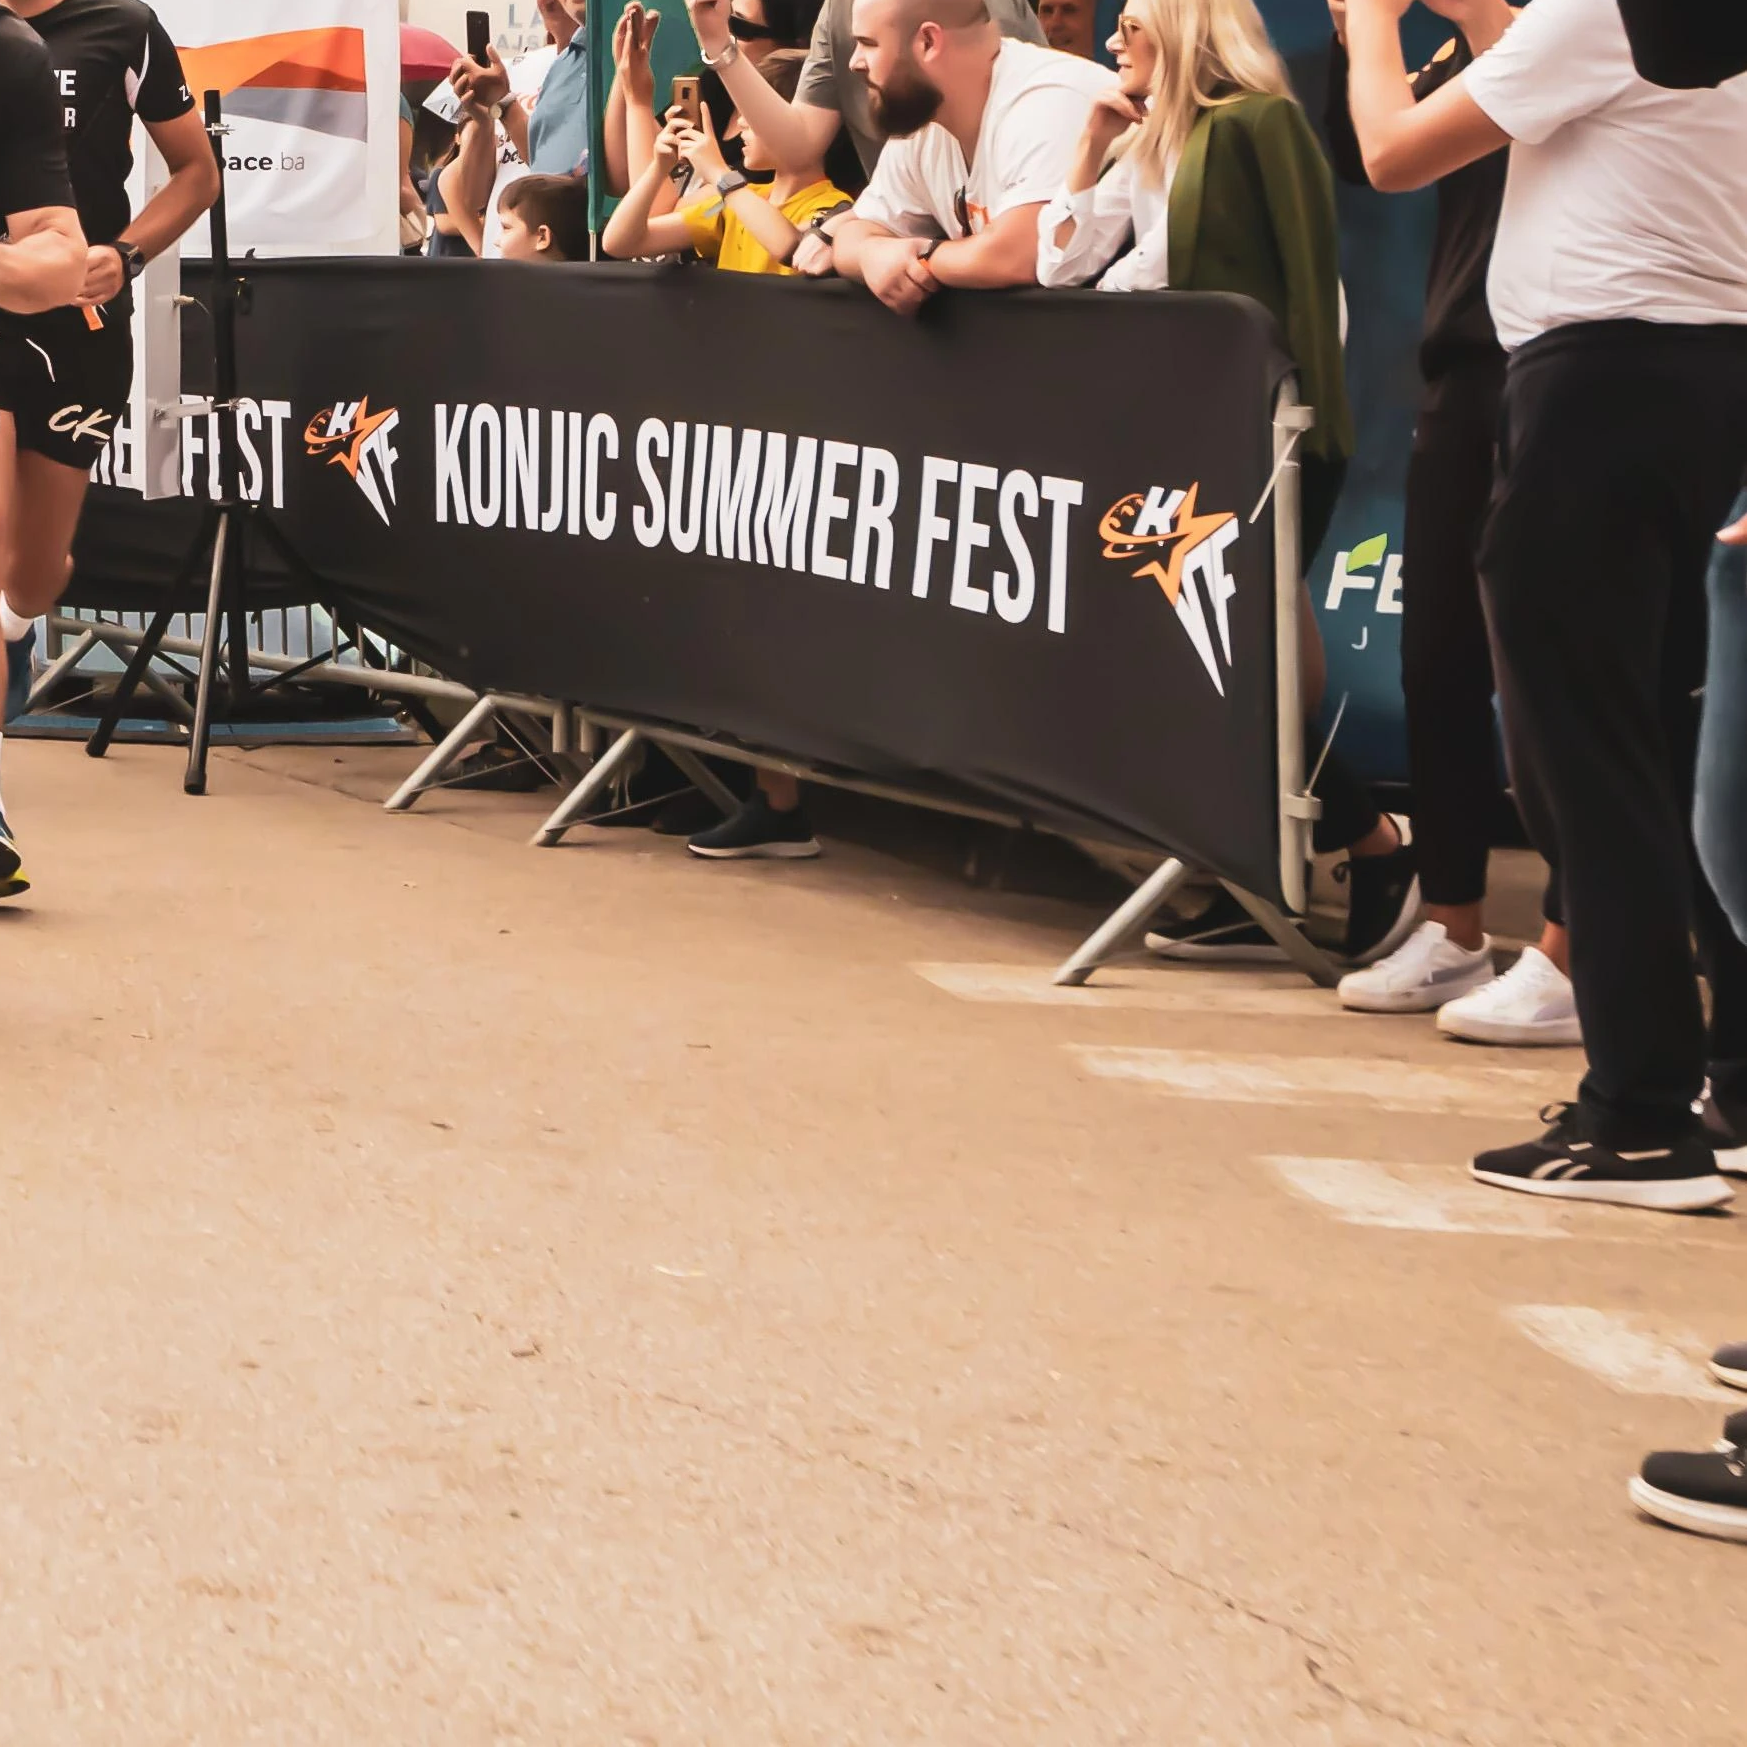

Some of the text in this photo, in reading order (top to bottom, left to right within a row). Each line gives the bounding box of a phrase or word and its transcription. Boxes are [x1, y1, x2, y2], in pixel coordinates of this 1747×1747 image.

[48, 404, 112, 442] CK
[434, 402, 1084, 635] KONJIC SUMMER FEST
